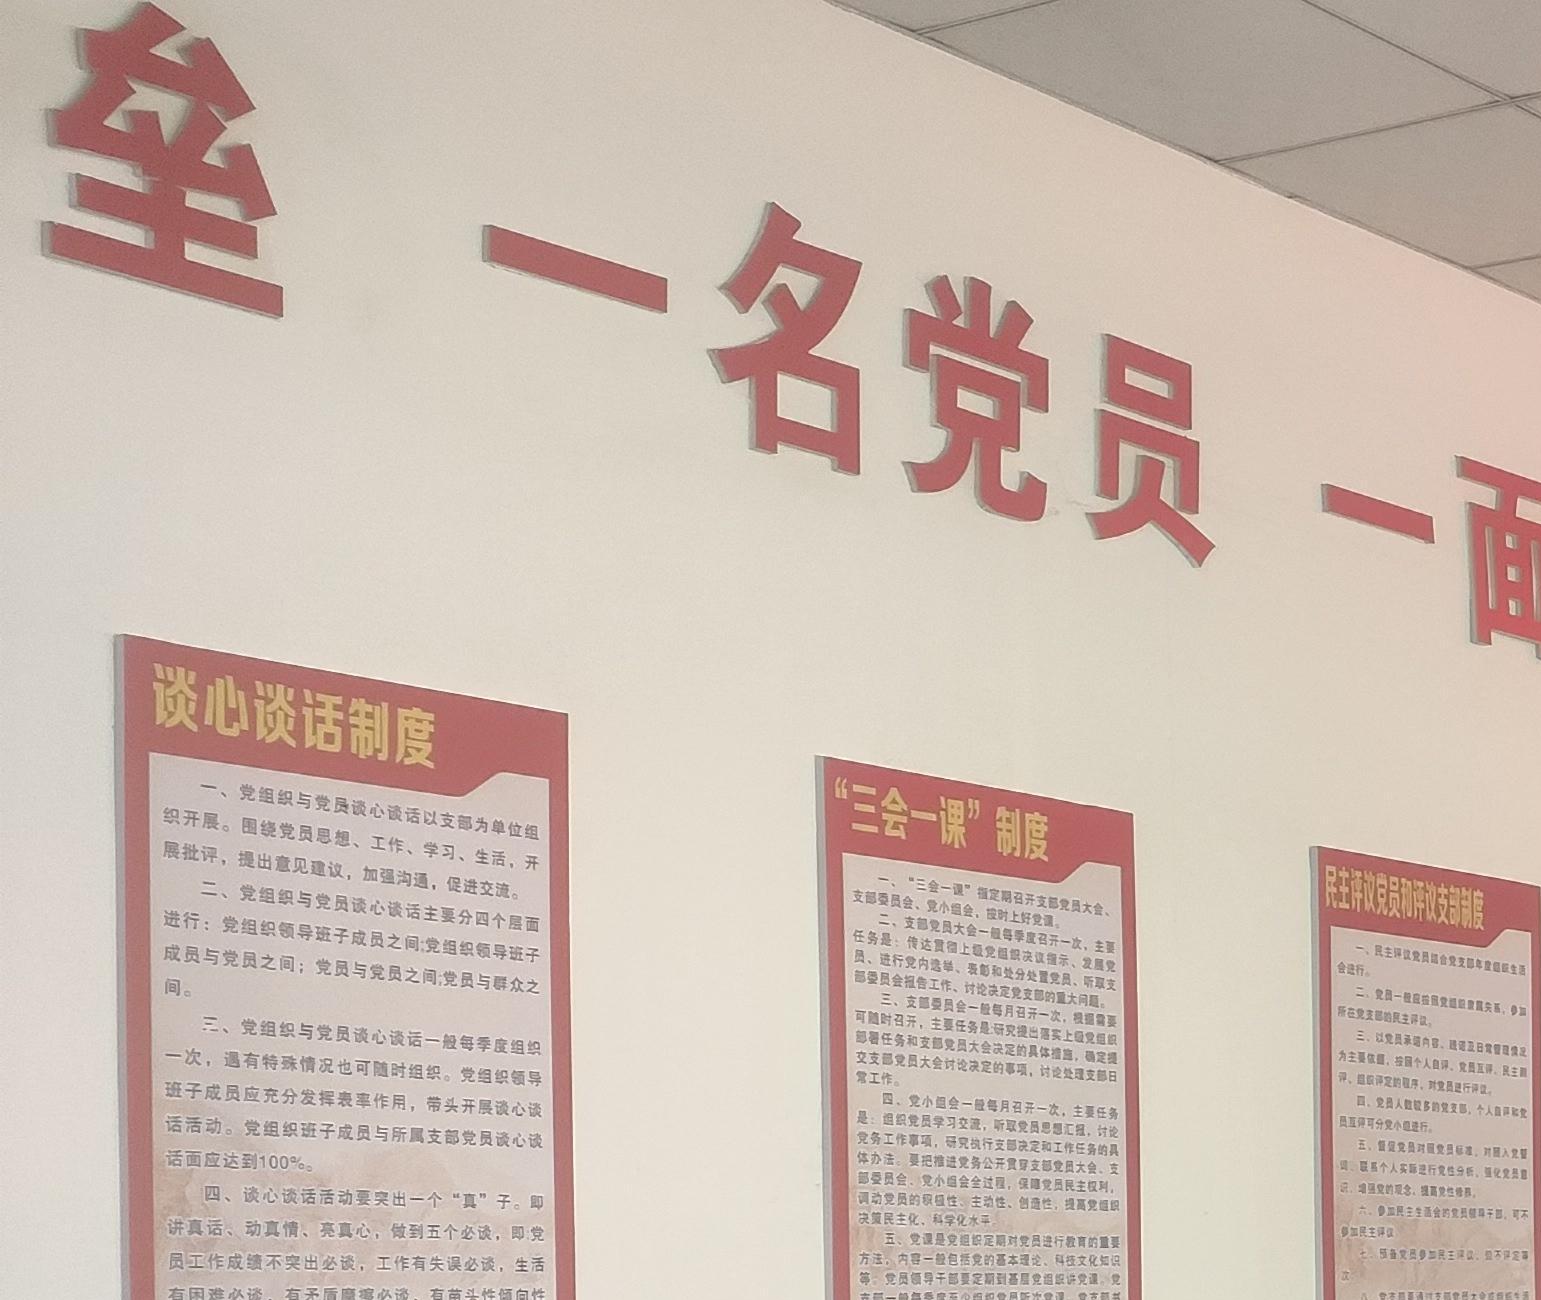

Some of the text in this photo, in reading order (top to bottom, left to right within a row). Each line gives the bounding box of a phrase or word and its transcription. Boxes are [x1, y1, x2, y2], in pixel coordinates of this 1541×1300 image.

[42, 1, 283, 318] 垒
[482, 201, 1215, 567] 一名党员
[152, 663, 435, 769] 谈心谈话制度
[200, 783, 539, 841] 一、党组织与党员谈心谈话以支部为单位组
[162, 806, 539, 871] 织开展。围绕党员思想、工作、学习、生活，开
[162, 840, 518, 900] 展批评，提出意见建议，加强沟通，促进交流。
[201, 881, 540, 932] 二、党组织与党员谈心谈话主要分四个层面
[1325, 864, 1484, 930] 民主评议党员和评议支部制度
[164, 977, 192, 998] 间。
[202, 1016, 541, 1056] 三、党组织与党员谈心谈话一般每季度组织
[165, 1048, 541, 1087] 一次，遇有特殊情况也可随时组织。党组织领导
[165, 1081, 542, 1118] 班子成员应充分发挥表率作用，带头开展谈心谈
[165, 1116, 542, 1149] 话活动。党组织班子成员与所属支部党员谈心谈
[168, 1254, 545, 1273] 员工作成绩不突出必谈，工作有失误必谈，生活
